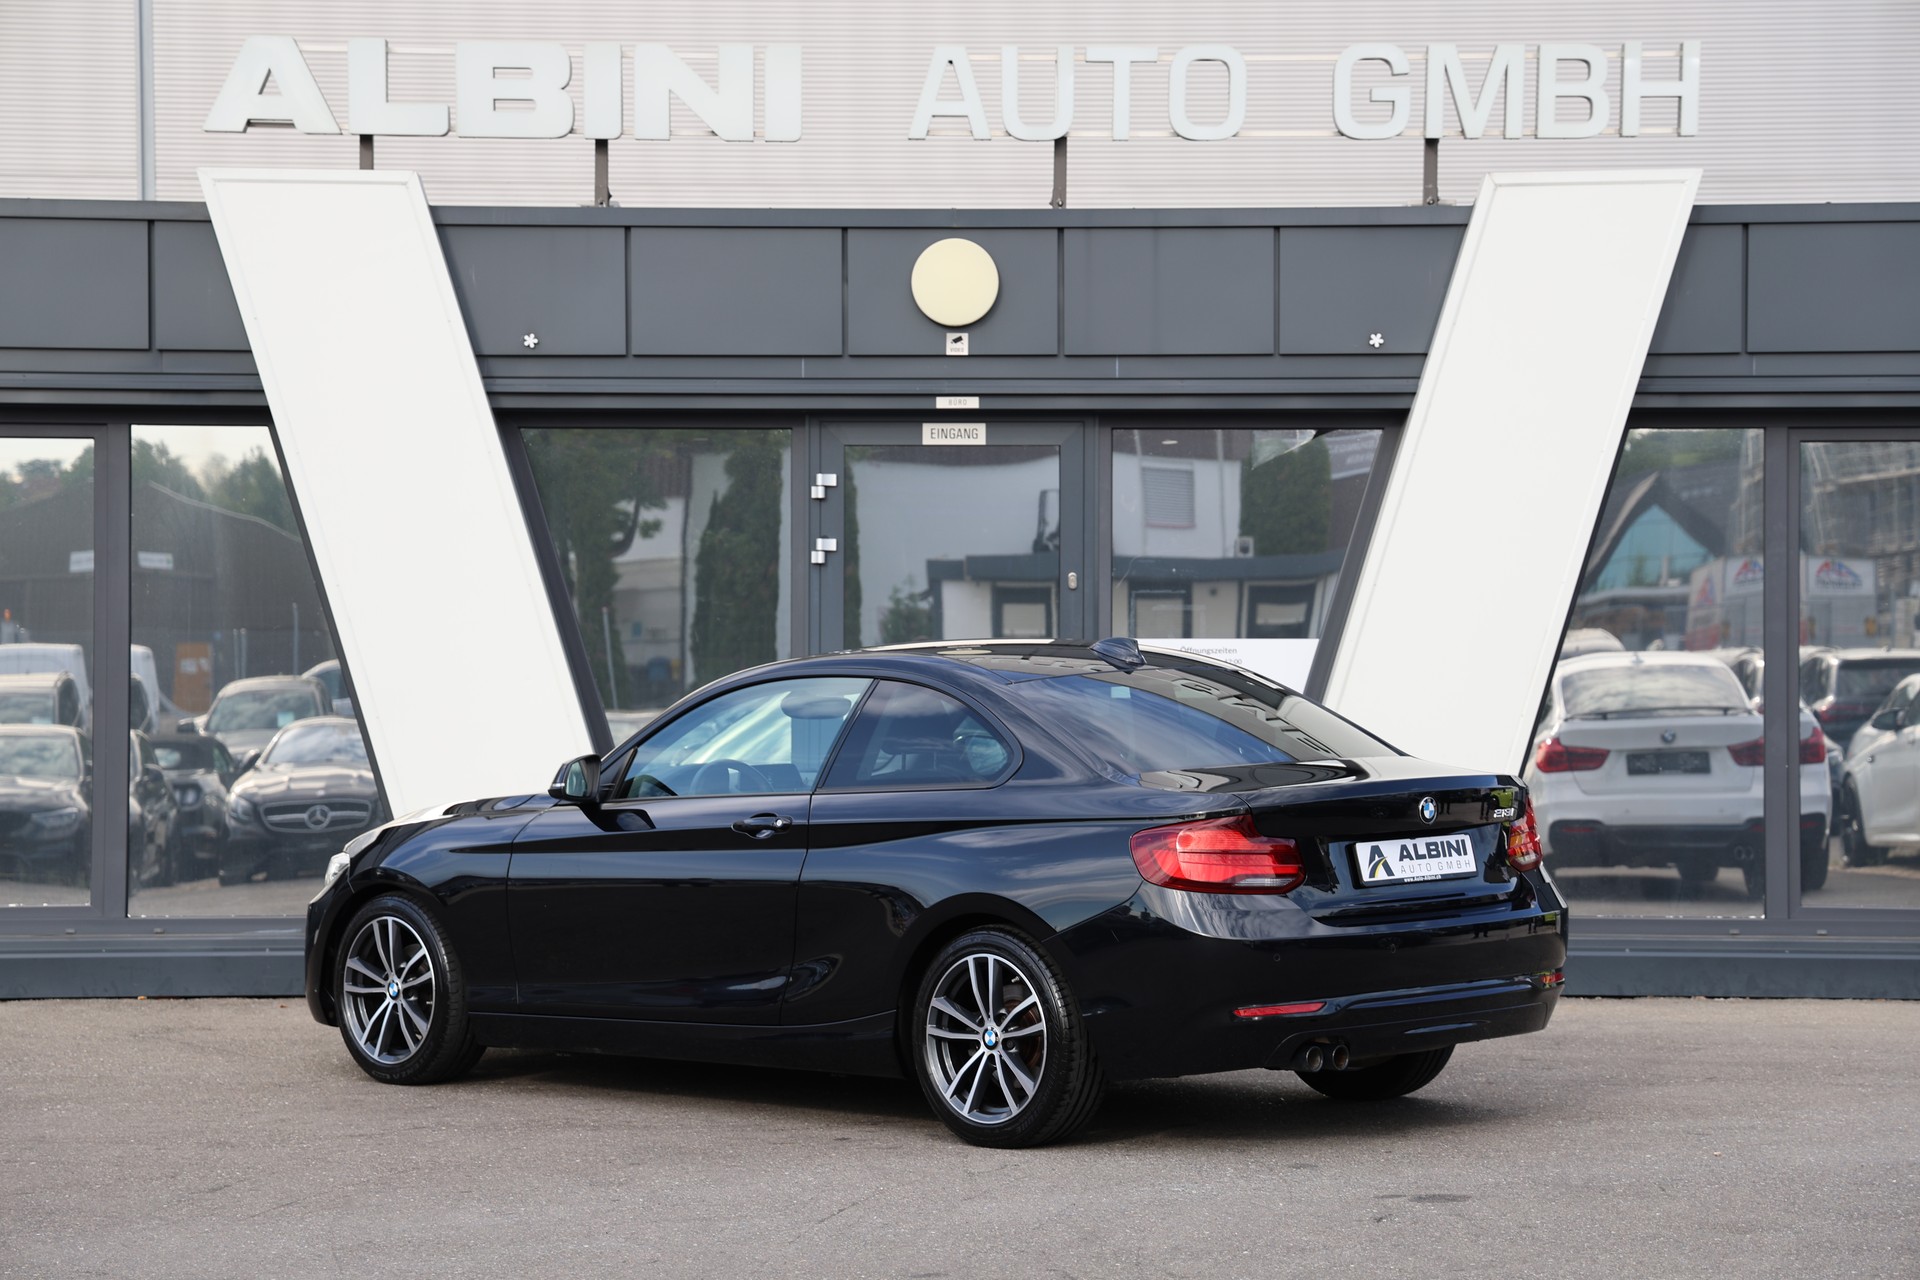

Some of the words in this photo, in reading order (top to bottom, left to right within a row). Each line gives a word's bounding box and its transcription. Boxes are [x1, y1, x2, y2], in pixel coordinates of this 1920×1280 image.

[203, 34, 801, 142] ALBINI
[907, 44, 1247, 142] AUTO
[1332, 40, 1700, 140] GMBH
[948, 398, 967, 406] BÜRO
[930, 428, 979, 439] EINGANG
[1180, 646, 1238, 655] Öffnungszeiten
[1398, 838, 1468, 862] ALBINI
[1400, 862, 1432, 874] AUTO
[1438, 859, 1471, 872] GMBH
